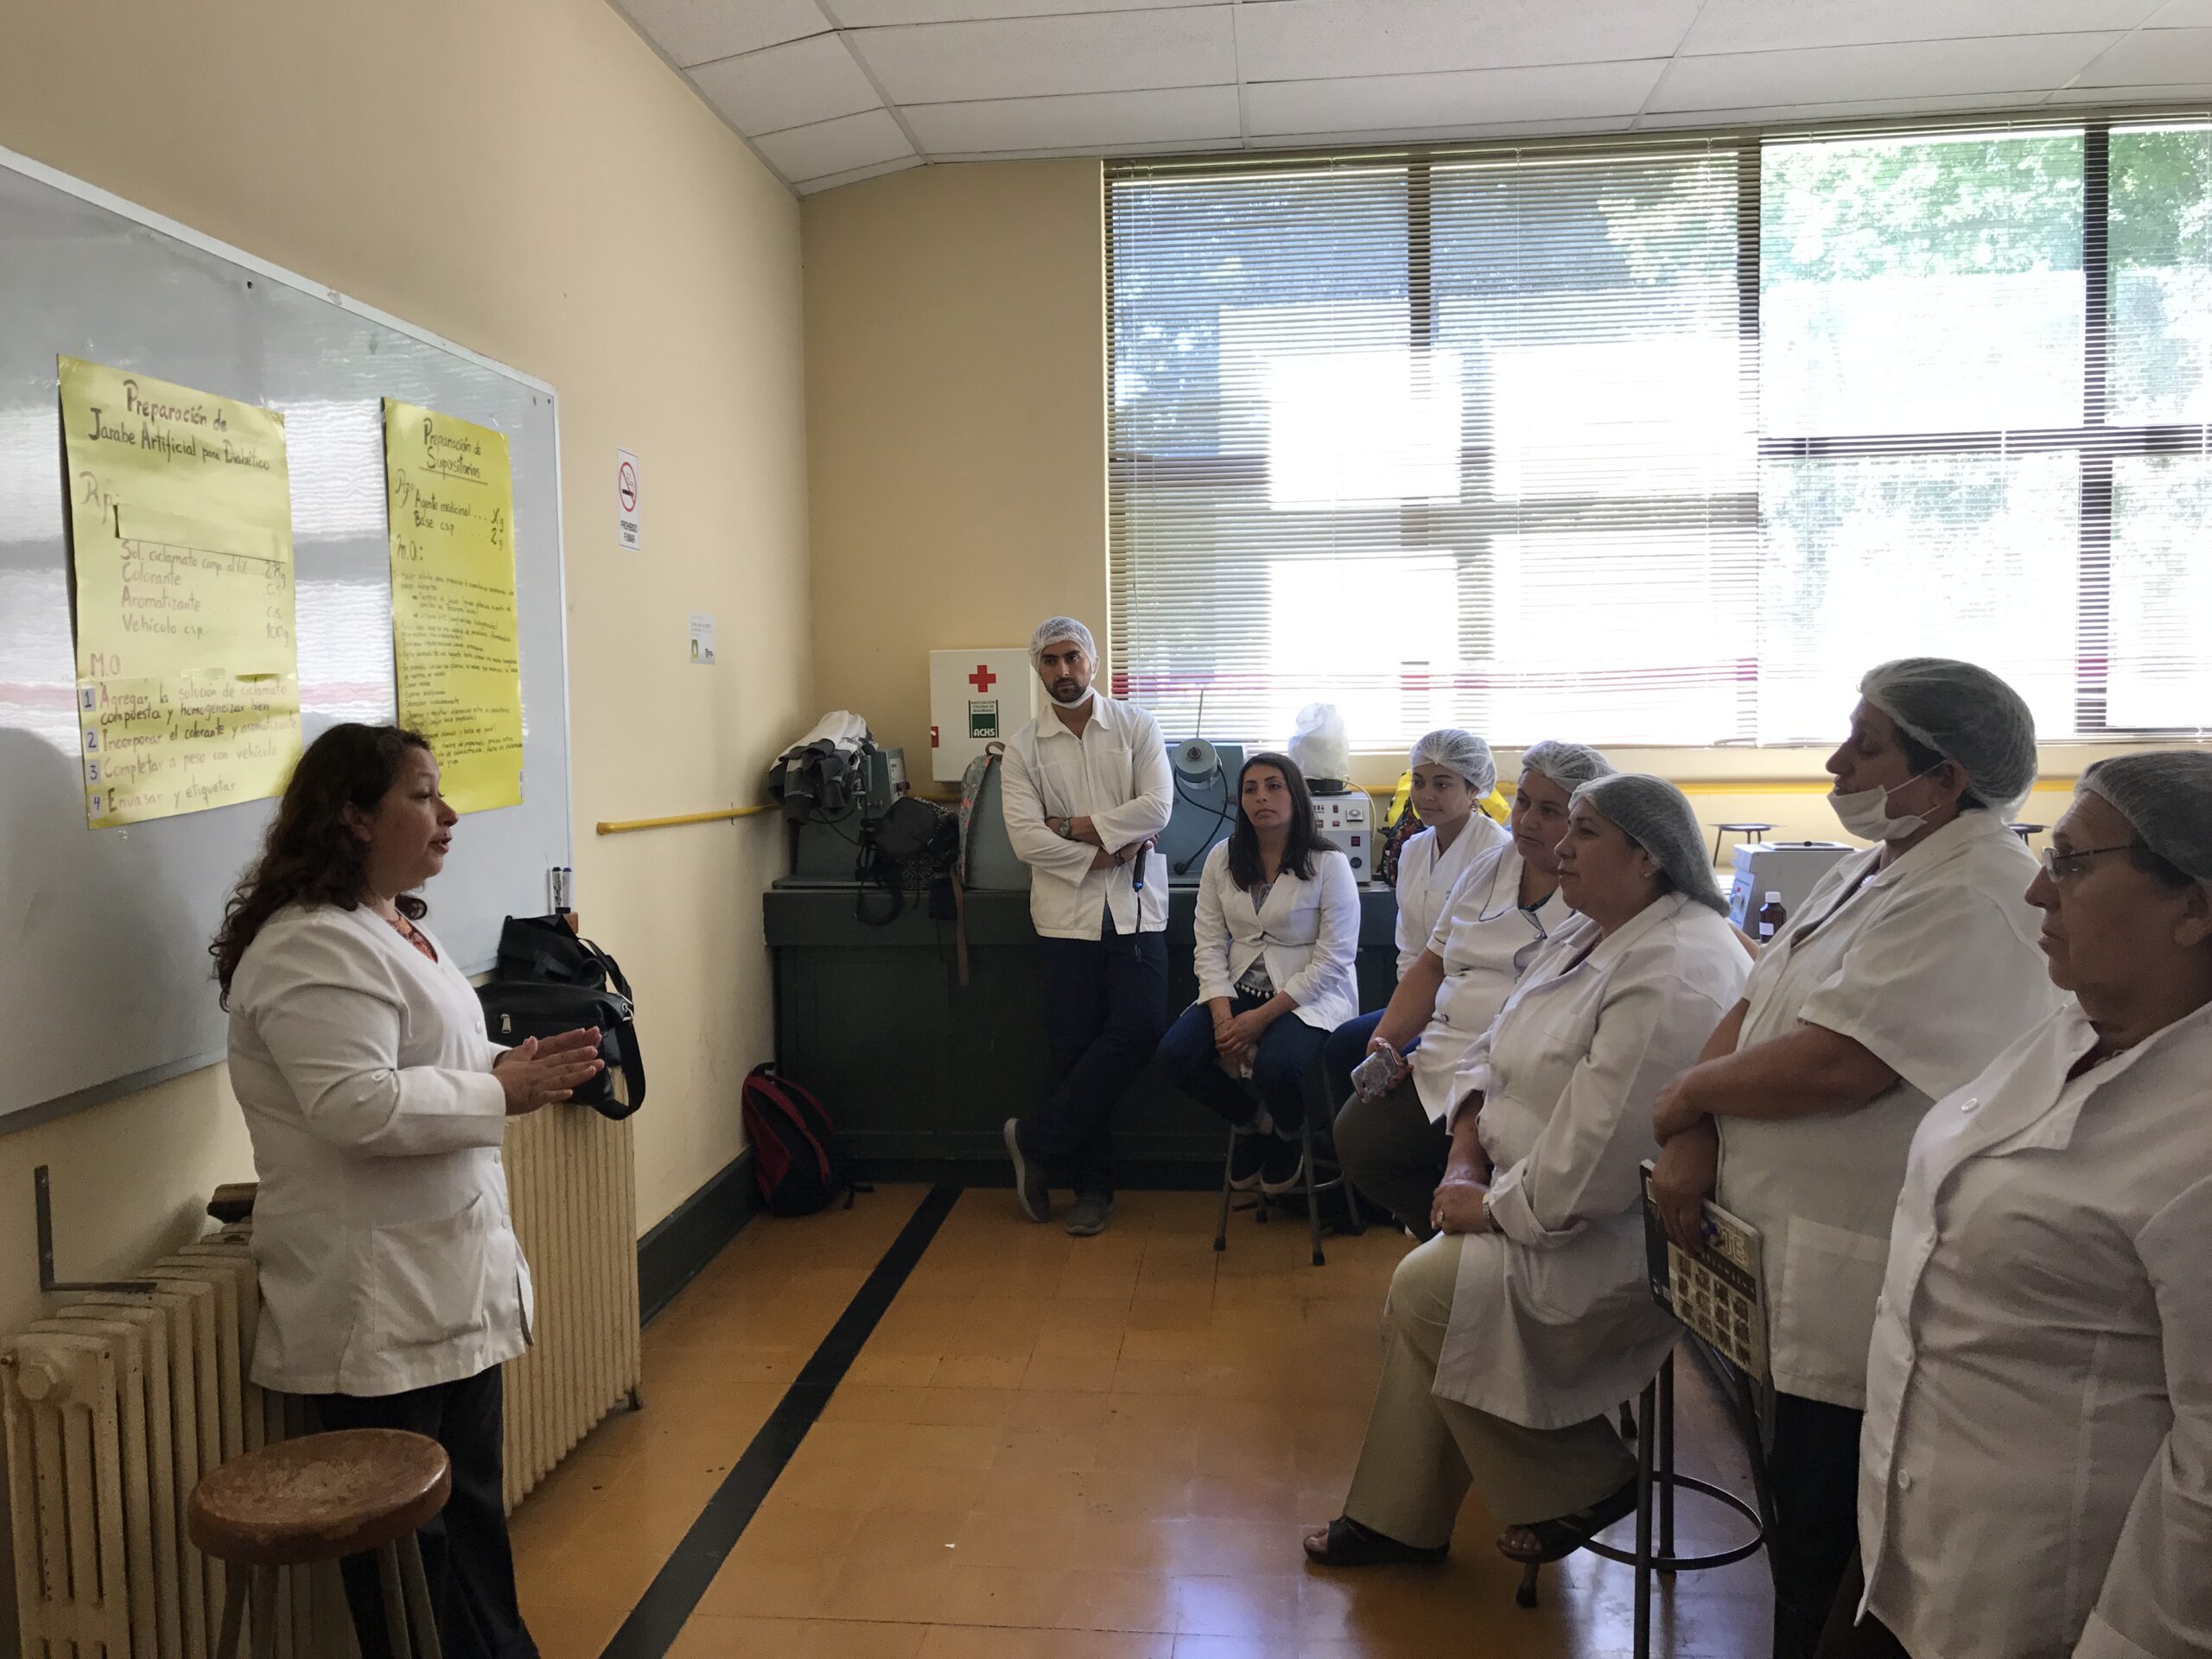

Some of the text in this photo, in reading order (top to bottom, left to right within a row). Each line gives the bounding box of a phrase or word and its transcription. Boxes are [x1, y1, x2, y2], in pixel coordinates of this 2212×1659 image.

[123, 379, 227, 432] Preparación de
[88, 407, 137, 445] Jarabe
[141, 422, 195, 462] Artificial
[202, 446, 220, 463] para
[423, 418, 481, 454] Preparación de
[415, 489, 439, 516] Agente
[441, 500, 471, 516] medicinal
[122, 563, 181, 586] Colorante
[122, 587, 200, 613] Aromatizante
[122, 614, 177, 635] Vehículo
[85, 690, 92, 708] 1
[99, 683, 149, 708] Agregar
[160, 685, 168, 704] la
[223, 682, 235, 697] de
[101, 702, 270, 728] compuesta y homogeneizar bien
[88, 732, 97, 748] 2
[103, 729, 162, 752] Incorporar
[169, 728, 178, 741] el
[184, 724, 225, 740] colorante
[232, 727, 238, 737] y
[90, 766, 97, 780] 3
[104, 758, 163, 783] Completar
[184, 753, 206, 769] peso
[93, 779, 236, 812] 4 Envasar y etiquetar
